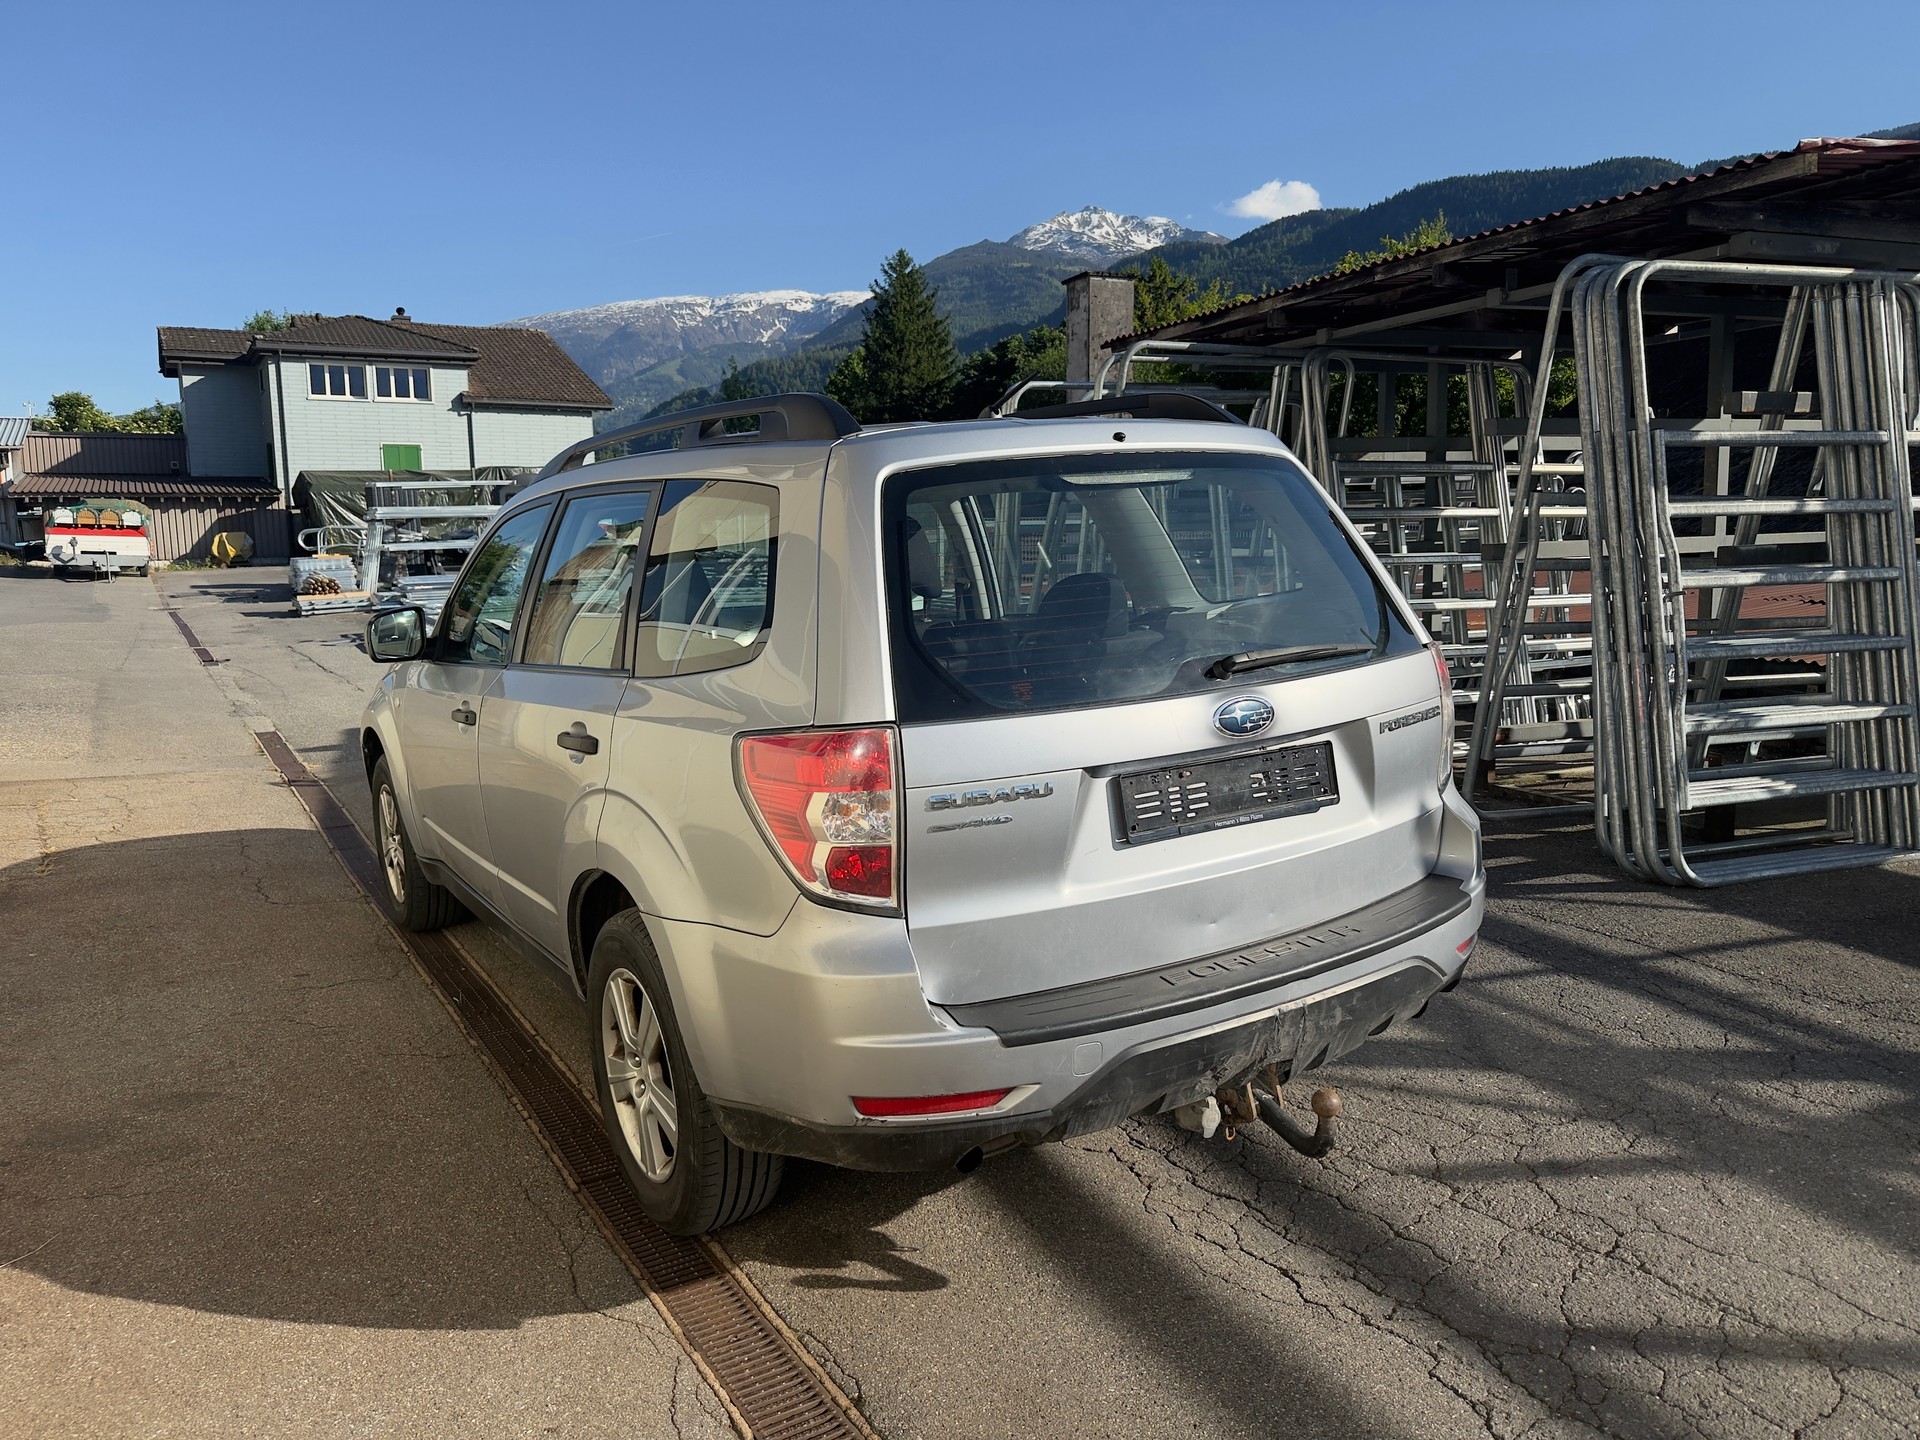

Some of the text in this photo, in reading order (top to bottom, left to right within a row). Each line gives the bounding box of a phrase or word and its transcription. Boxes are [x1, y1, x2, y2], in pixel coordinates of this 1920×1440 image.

[1379, 705, 1440, 734] FORESTER
[924, 782, 1054, 812] SUBARU
[1159, 925, 1362, 987] FORESTER
